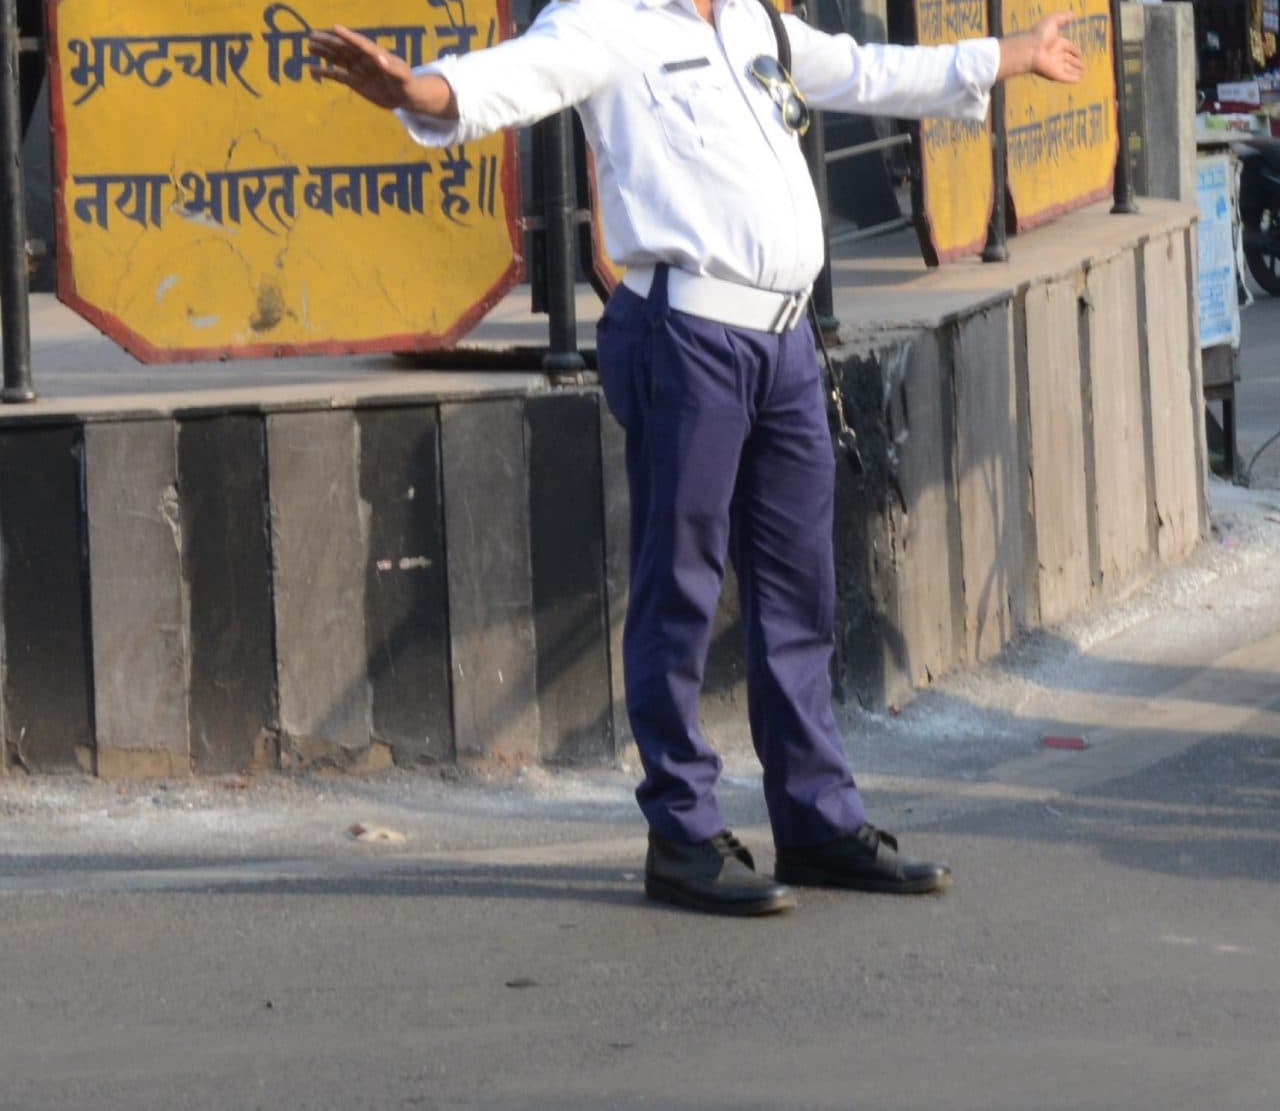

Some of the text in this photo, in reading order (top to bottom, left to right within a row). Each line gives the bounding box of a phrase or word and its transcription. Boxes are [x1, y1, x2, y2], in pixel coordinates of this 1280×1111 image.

[74, 174, 171, 230] नया
[181, 165, 299, 234] भारत
[305, 161, 431, 216] बनाना
